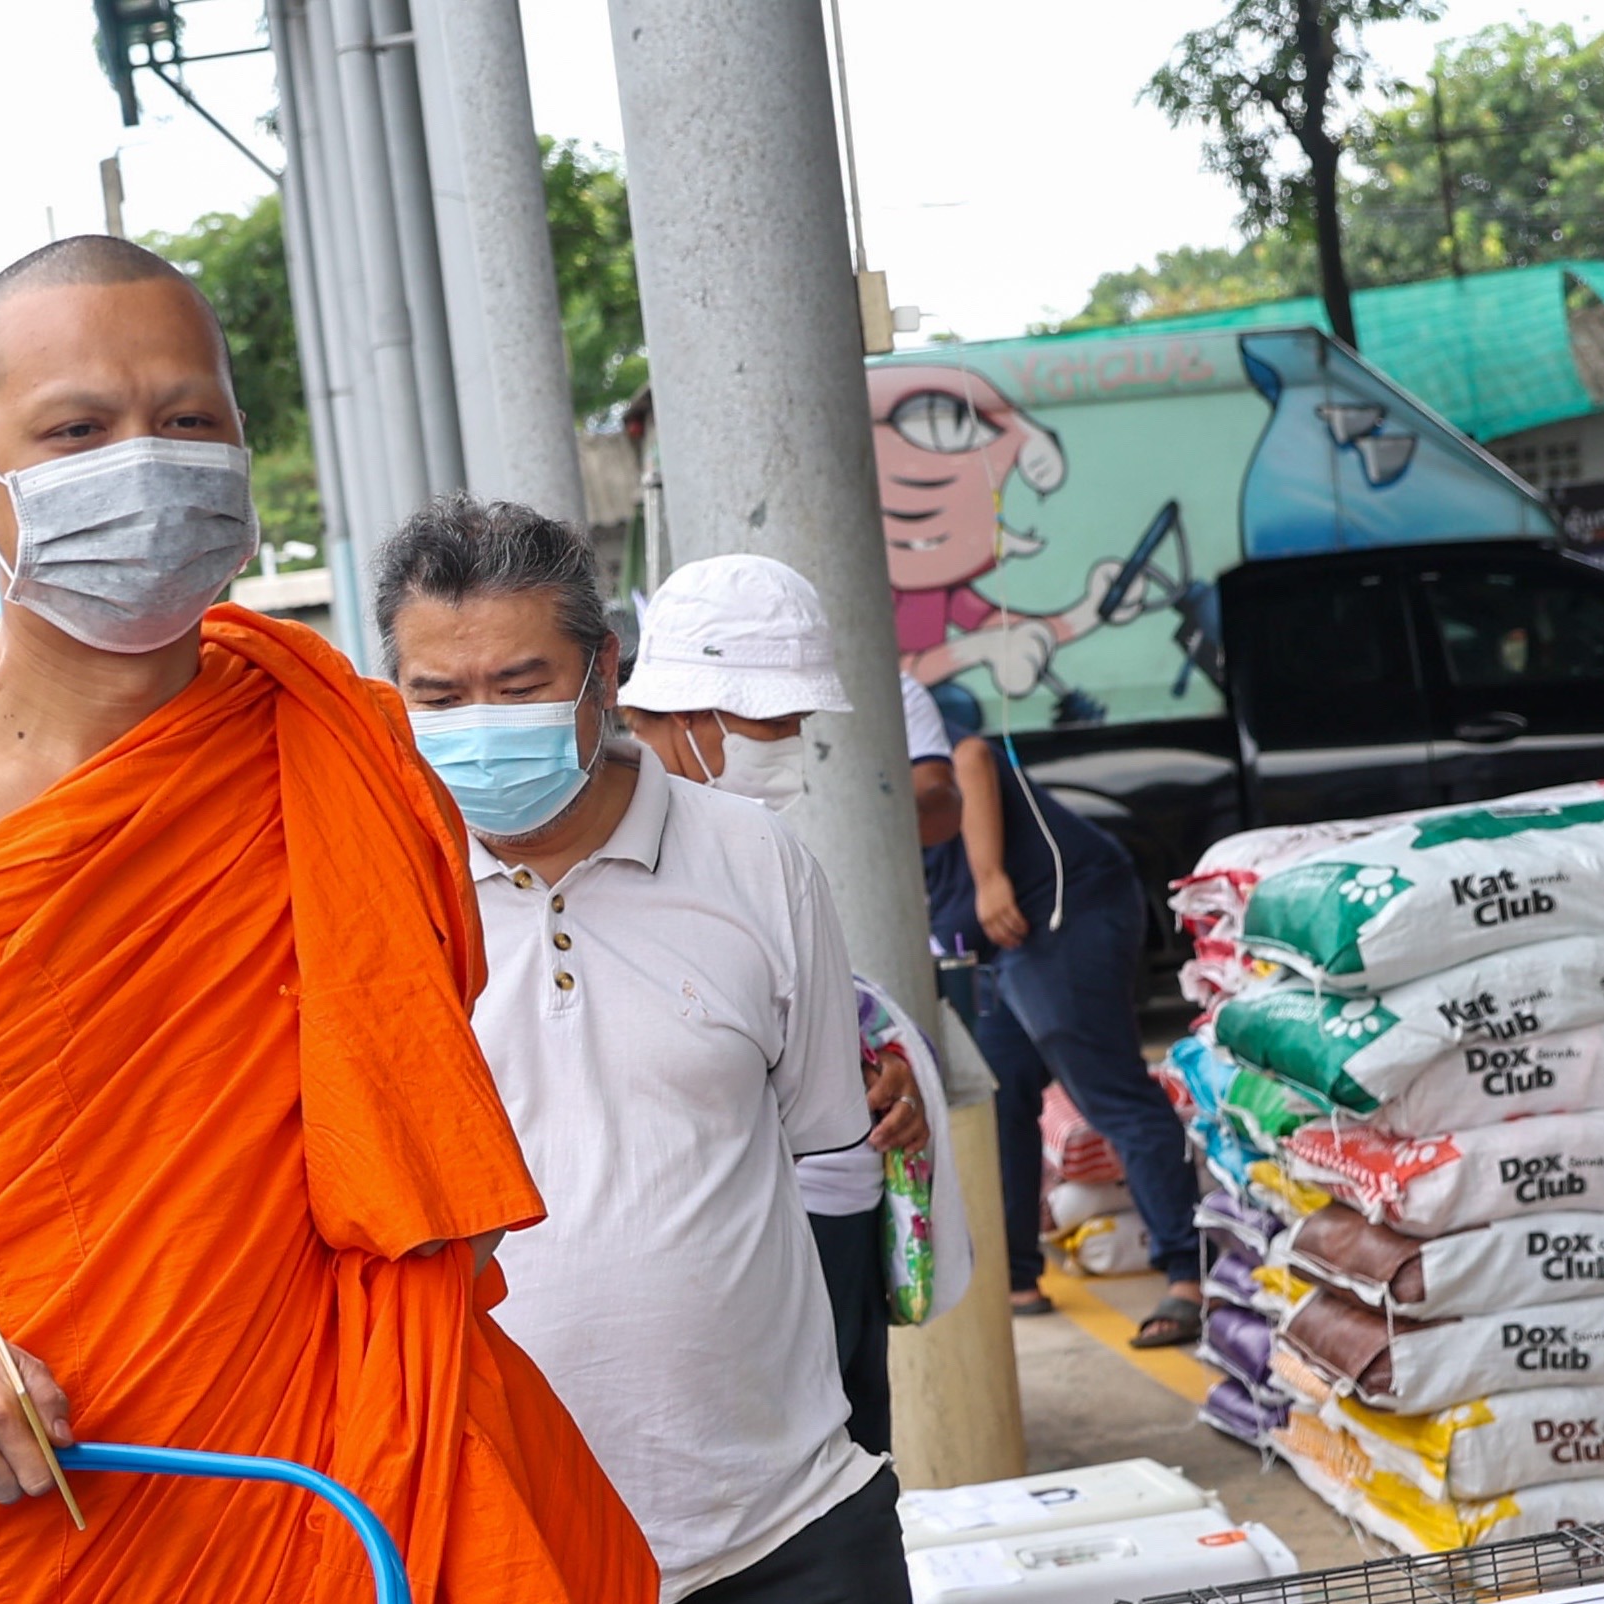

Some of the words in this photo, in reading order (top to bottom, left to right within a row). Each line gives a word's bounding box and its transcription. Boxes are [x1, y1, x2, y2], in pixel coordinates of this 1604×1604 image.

[1450, 868, 1519, 906] Kat
[1473, 889, 1557, 928] Club
[1438, 991, 1499, 1028] Kat
[1464, 1046, 1533, 1074] Dox
[1482, 1065, 1556, 1097] Club
[1499, 1153, 1564, 1184] Dox
[1514, 1172, 1588, 1204] Club
[1527, 1231, 1595, 1257] Dox
[1502, 1323, 1568, 1349] Dox
[1516, 1347, 1592, 1371] Club
[1532, 1417, 1599, 1445] Dox
